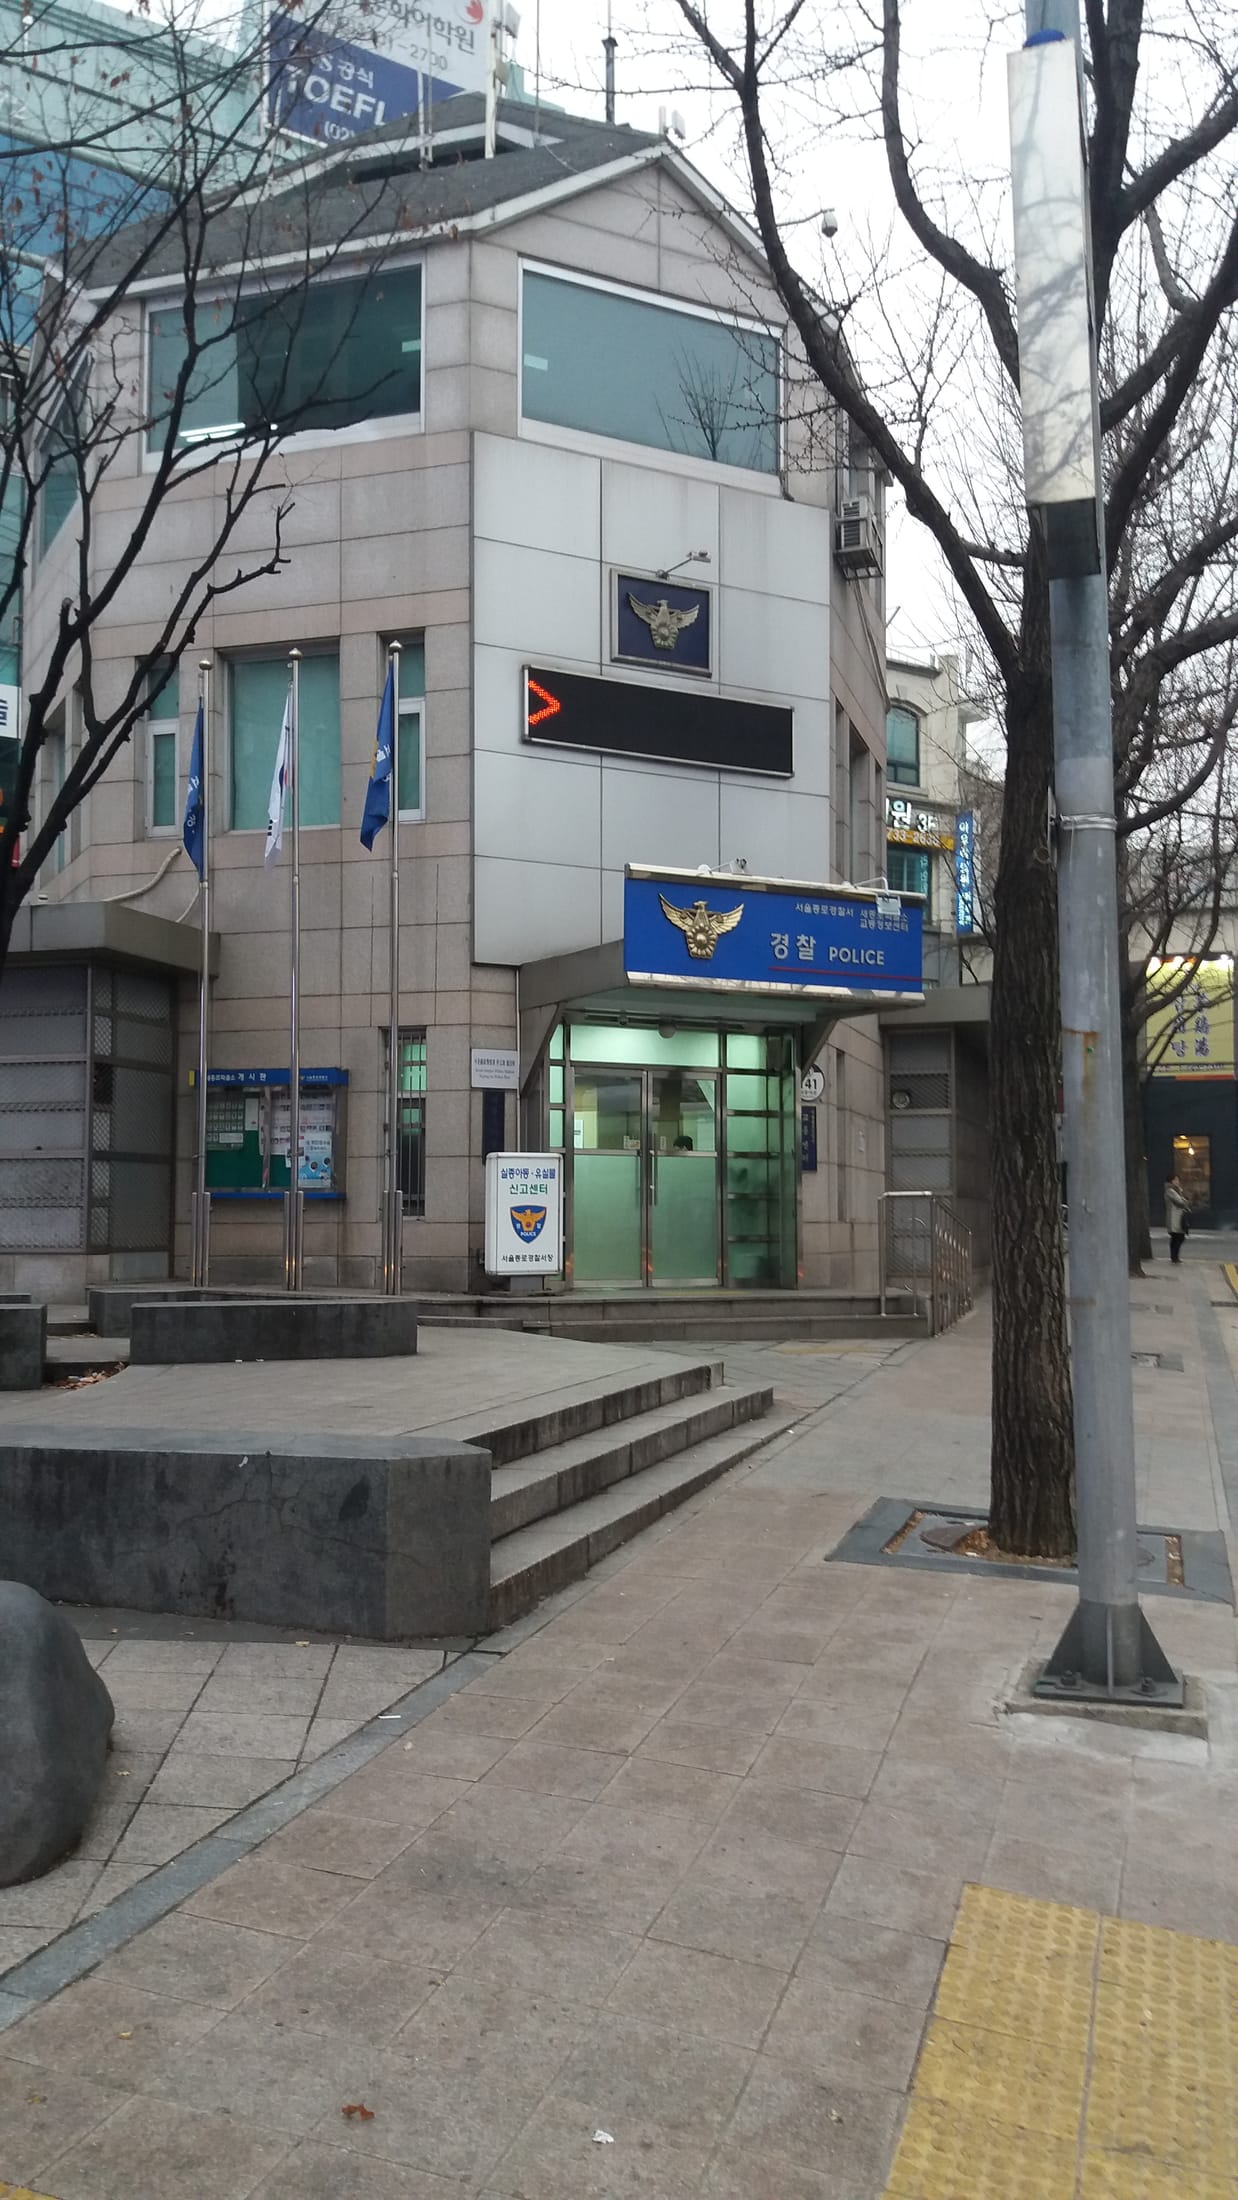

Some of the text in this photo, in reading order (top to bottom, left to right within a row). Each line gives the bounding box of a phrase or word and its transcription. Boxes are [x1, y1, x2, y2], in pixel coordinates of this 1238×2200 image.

[885, 797, 912, 830] 원
[770, 932, 885, 966] 경찰 POLICE
[509, 1183, 548, 1196] 신고센터
